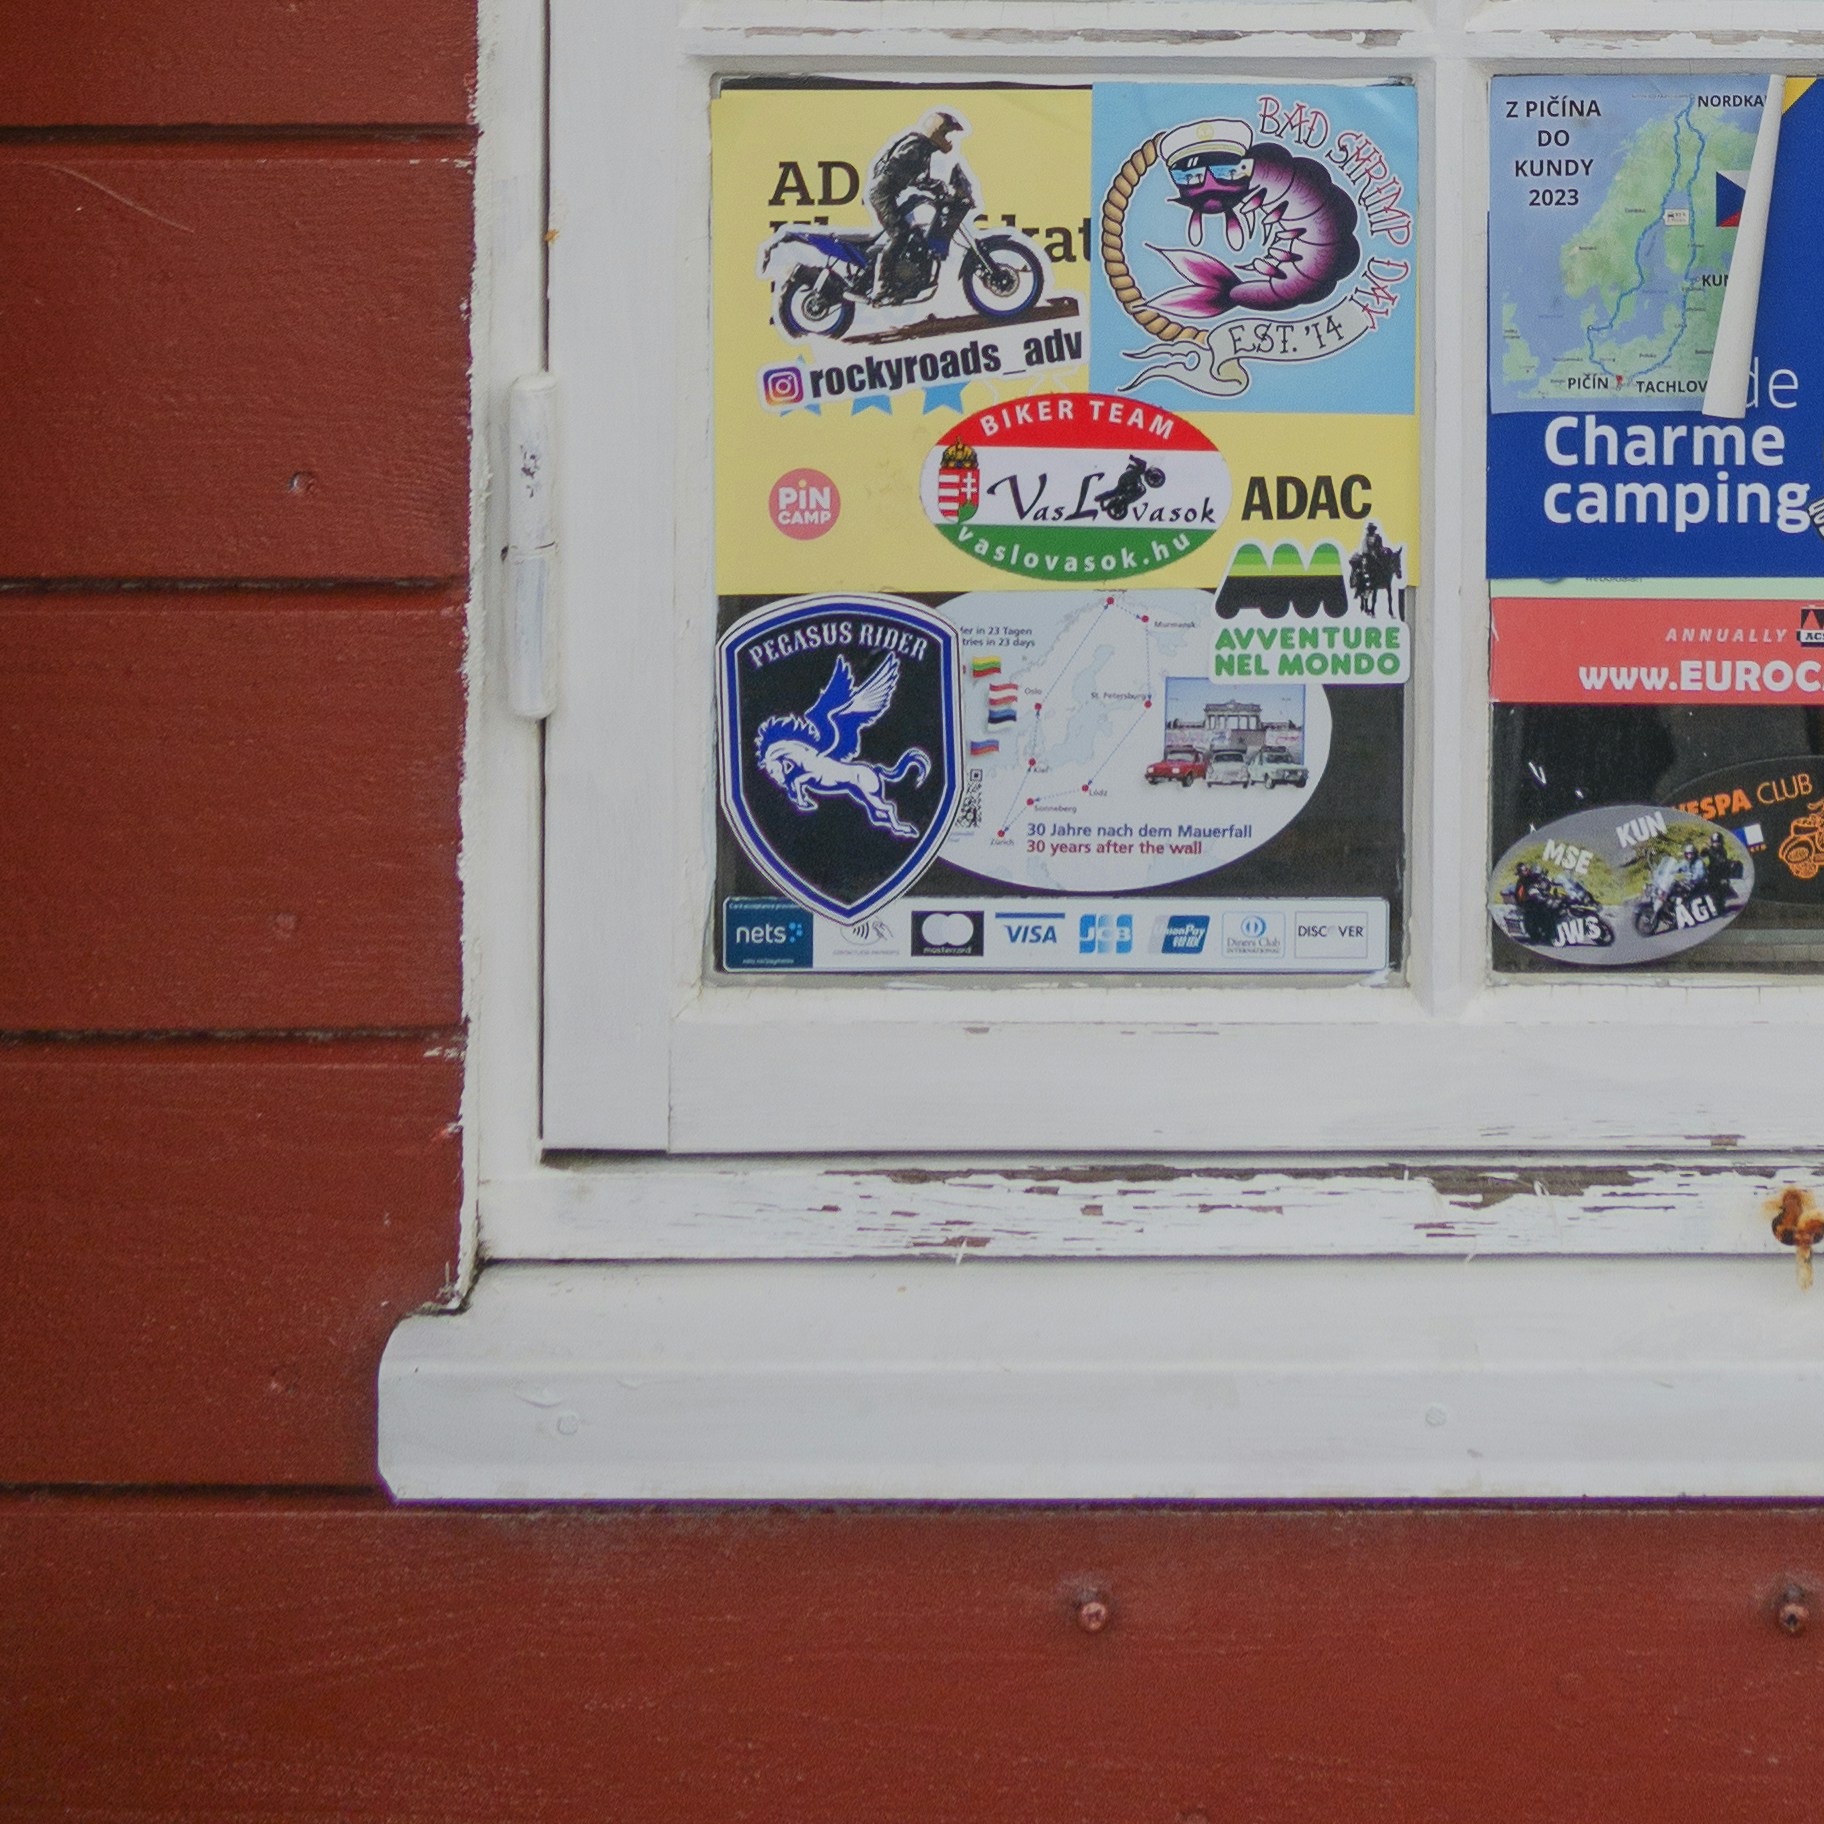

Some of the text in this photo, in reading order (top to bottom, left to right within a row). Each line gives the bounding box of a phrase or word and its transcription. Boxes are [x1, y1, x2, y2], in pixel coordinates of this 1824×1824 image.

[1506, 97, 1601, 118] Z PIČÍNA
[1537, 129, 1571, 148] DO
[1515, 158, 1594, 178] KUNDY
[1529, 188, 1580, 207] 2023
[810, 329, 1083, 397] rockyroads_adv
[1567, 373, 1609, 391] PIČÍN
[980, 401, 1174, 440] BIKER TEAM
[1543, 415, 1786, 466] Charme
[1241, 475, 1373, 520] ADAC
[1543, 474, 1811, 533] camping
[956, 524, 1190, 572] vaslovasok.hu
[1215, 627, 1401, 650] AVVENTURE
[1665, 628, 1788, 643] ANNUALLY
[1216, 652, 1400, 677] NEL MONDO
[1756, 775, 1813, 806] CLUB
[1027, 823, 1252, 840] 30 Jahre nach dem Mauerfall
[1027, 841, 1201, 857] 30 years after the wall
[1004, 925, 1057, 944] VISA
